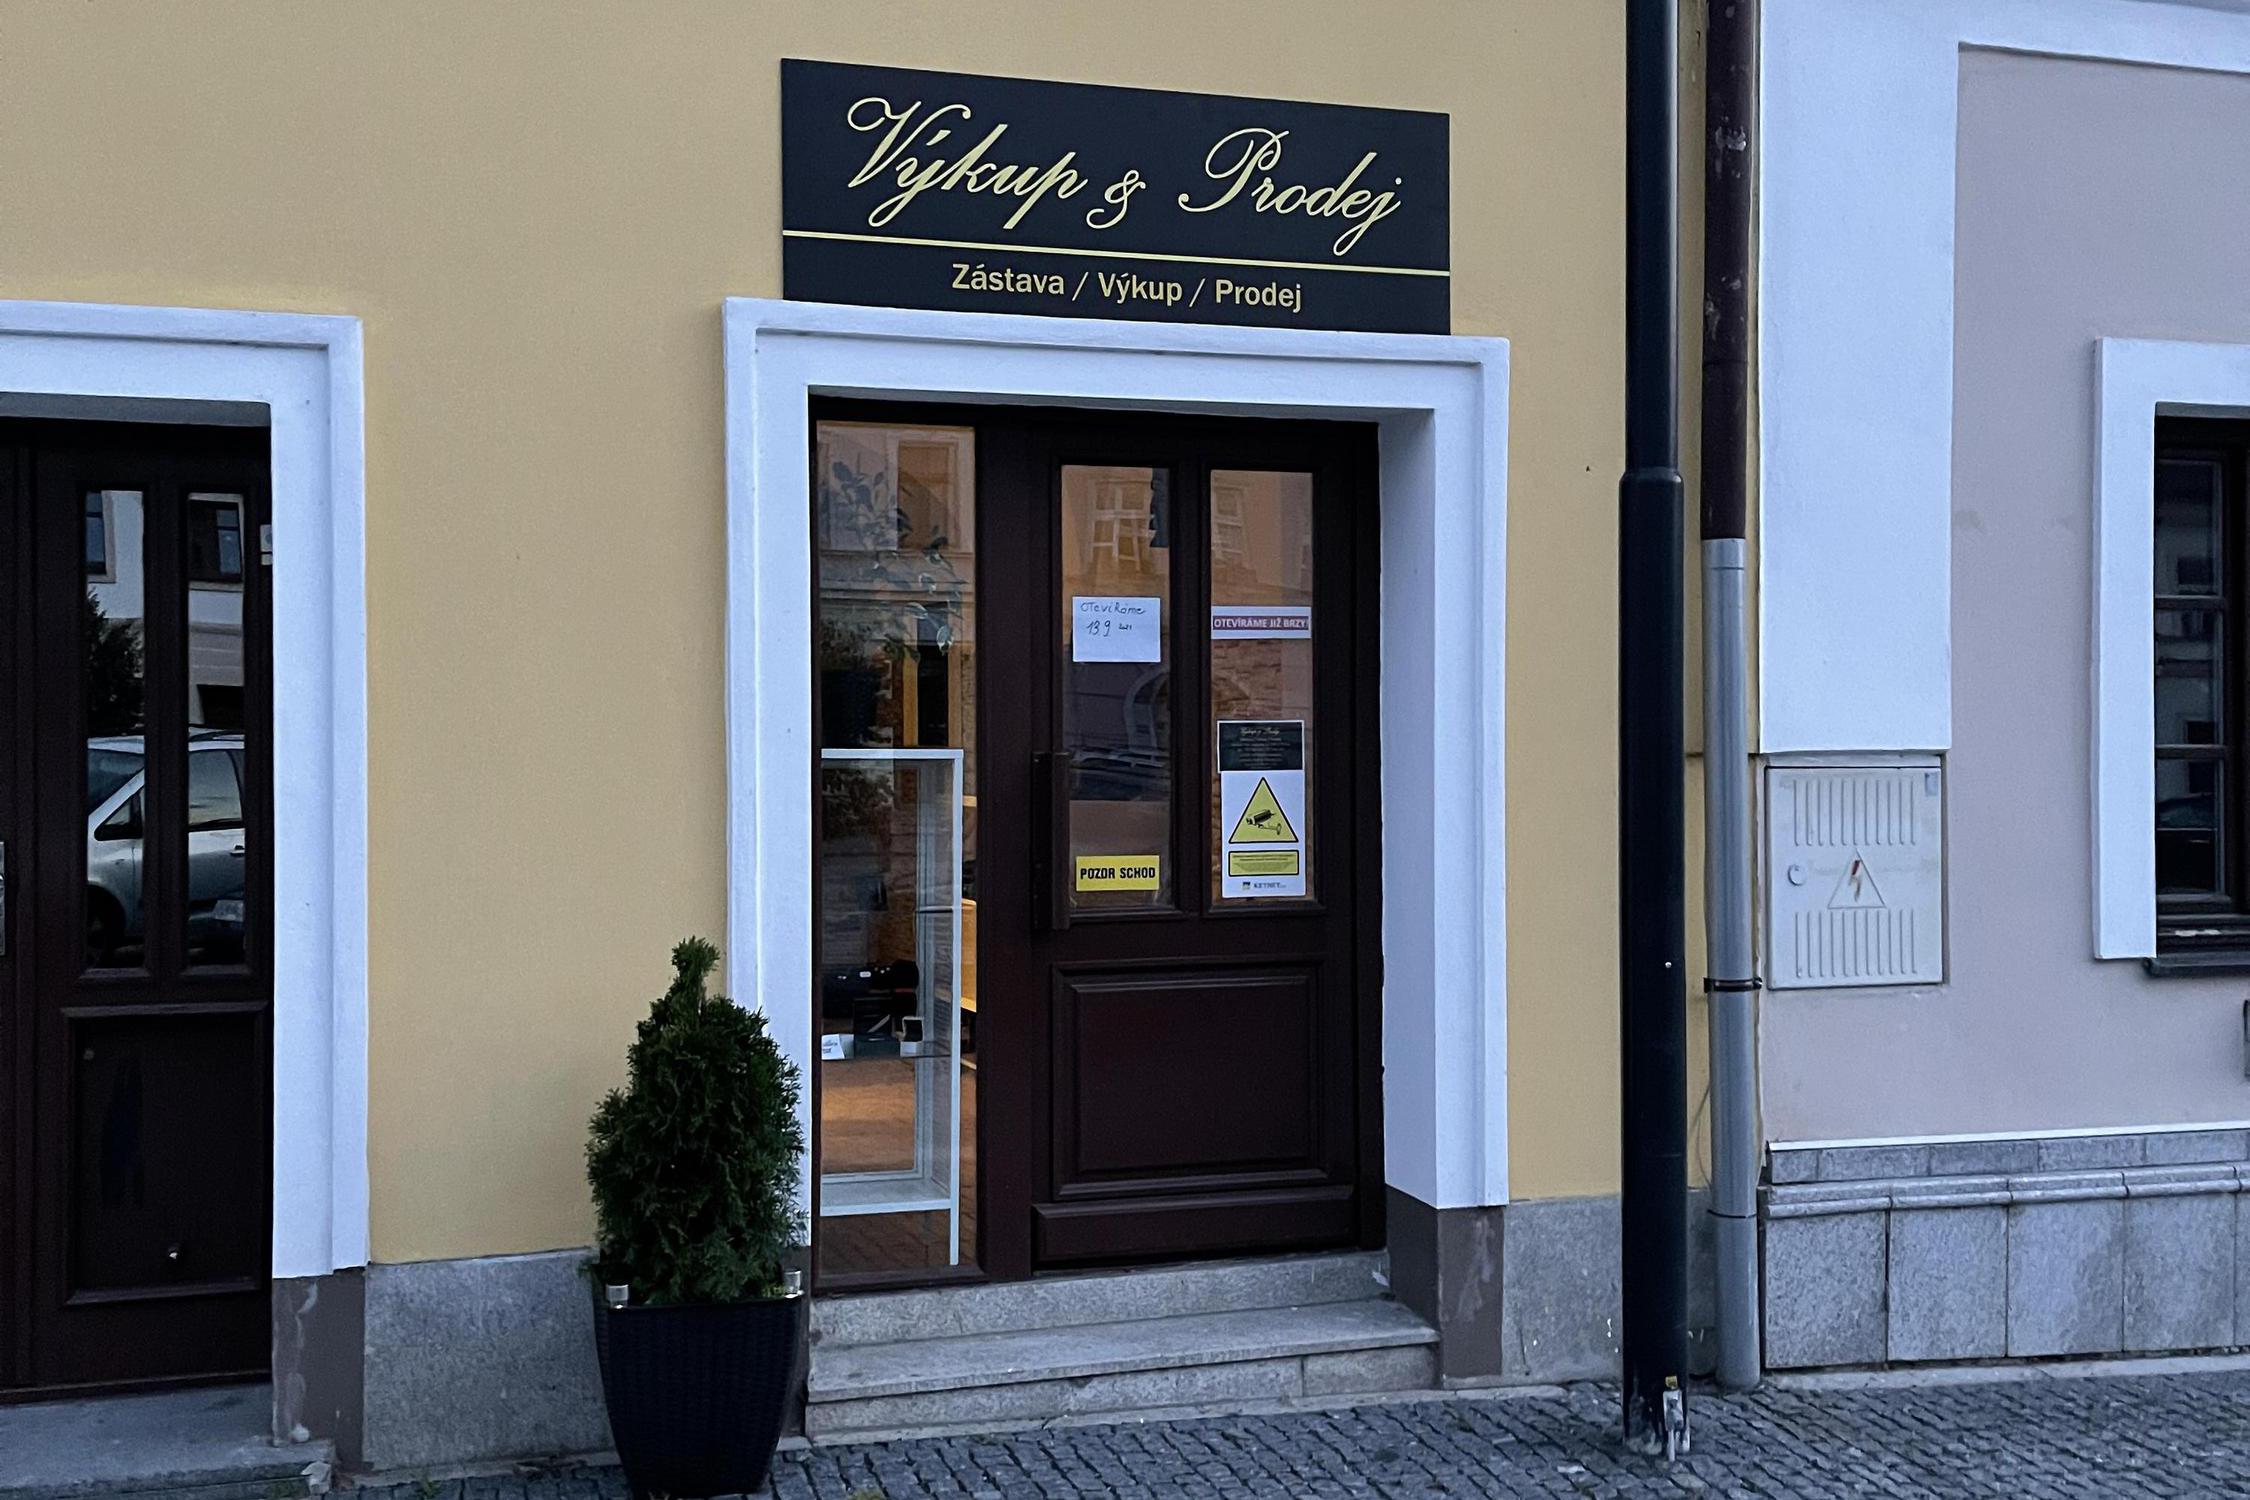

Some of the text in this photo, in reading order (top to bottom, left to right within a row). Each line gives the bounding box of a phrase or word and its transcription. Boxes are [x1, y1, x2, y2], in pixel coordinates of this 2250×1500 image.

[847, 97, 1402, 257] Výkup & Prodej
[952, 263, 1301, 314] Zástava / Výkup / Prodej
[1214, 617, 1268, 629] OTEVÍRÁME
[1270, 617, 1282, 628] JIŽ
[1080, 867, 1156, 879] POZOR SCHOD
